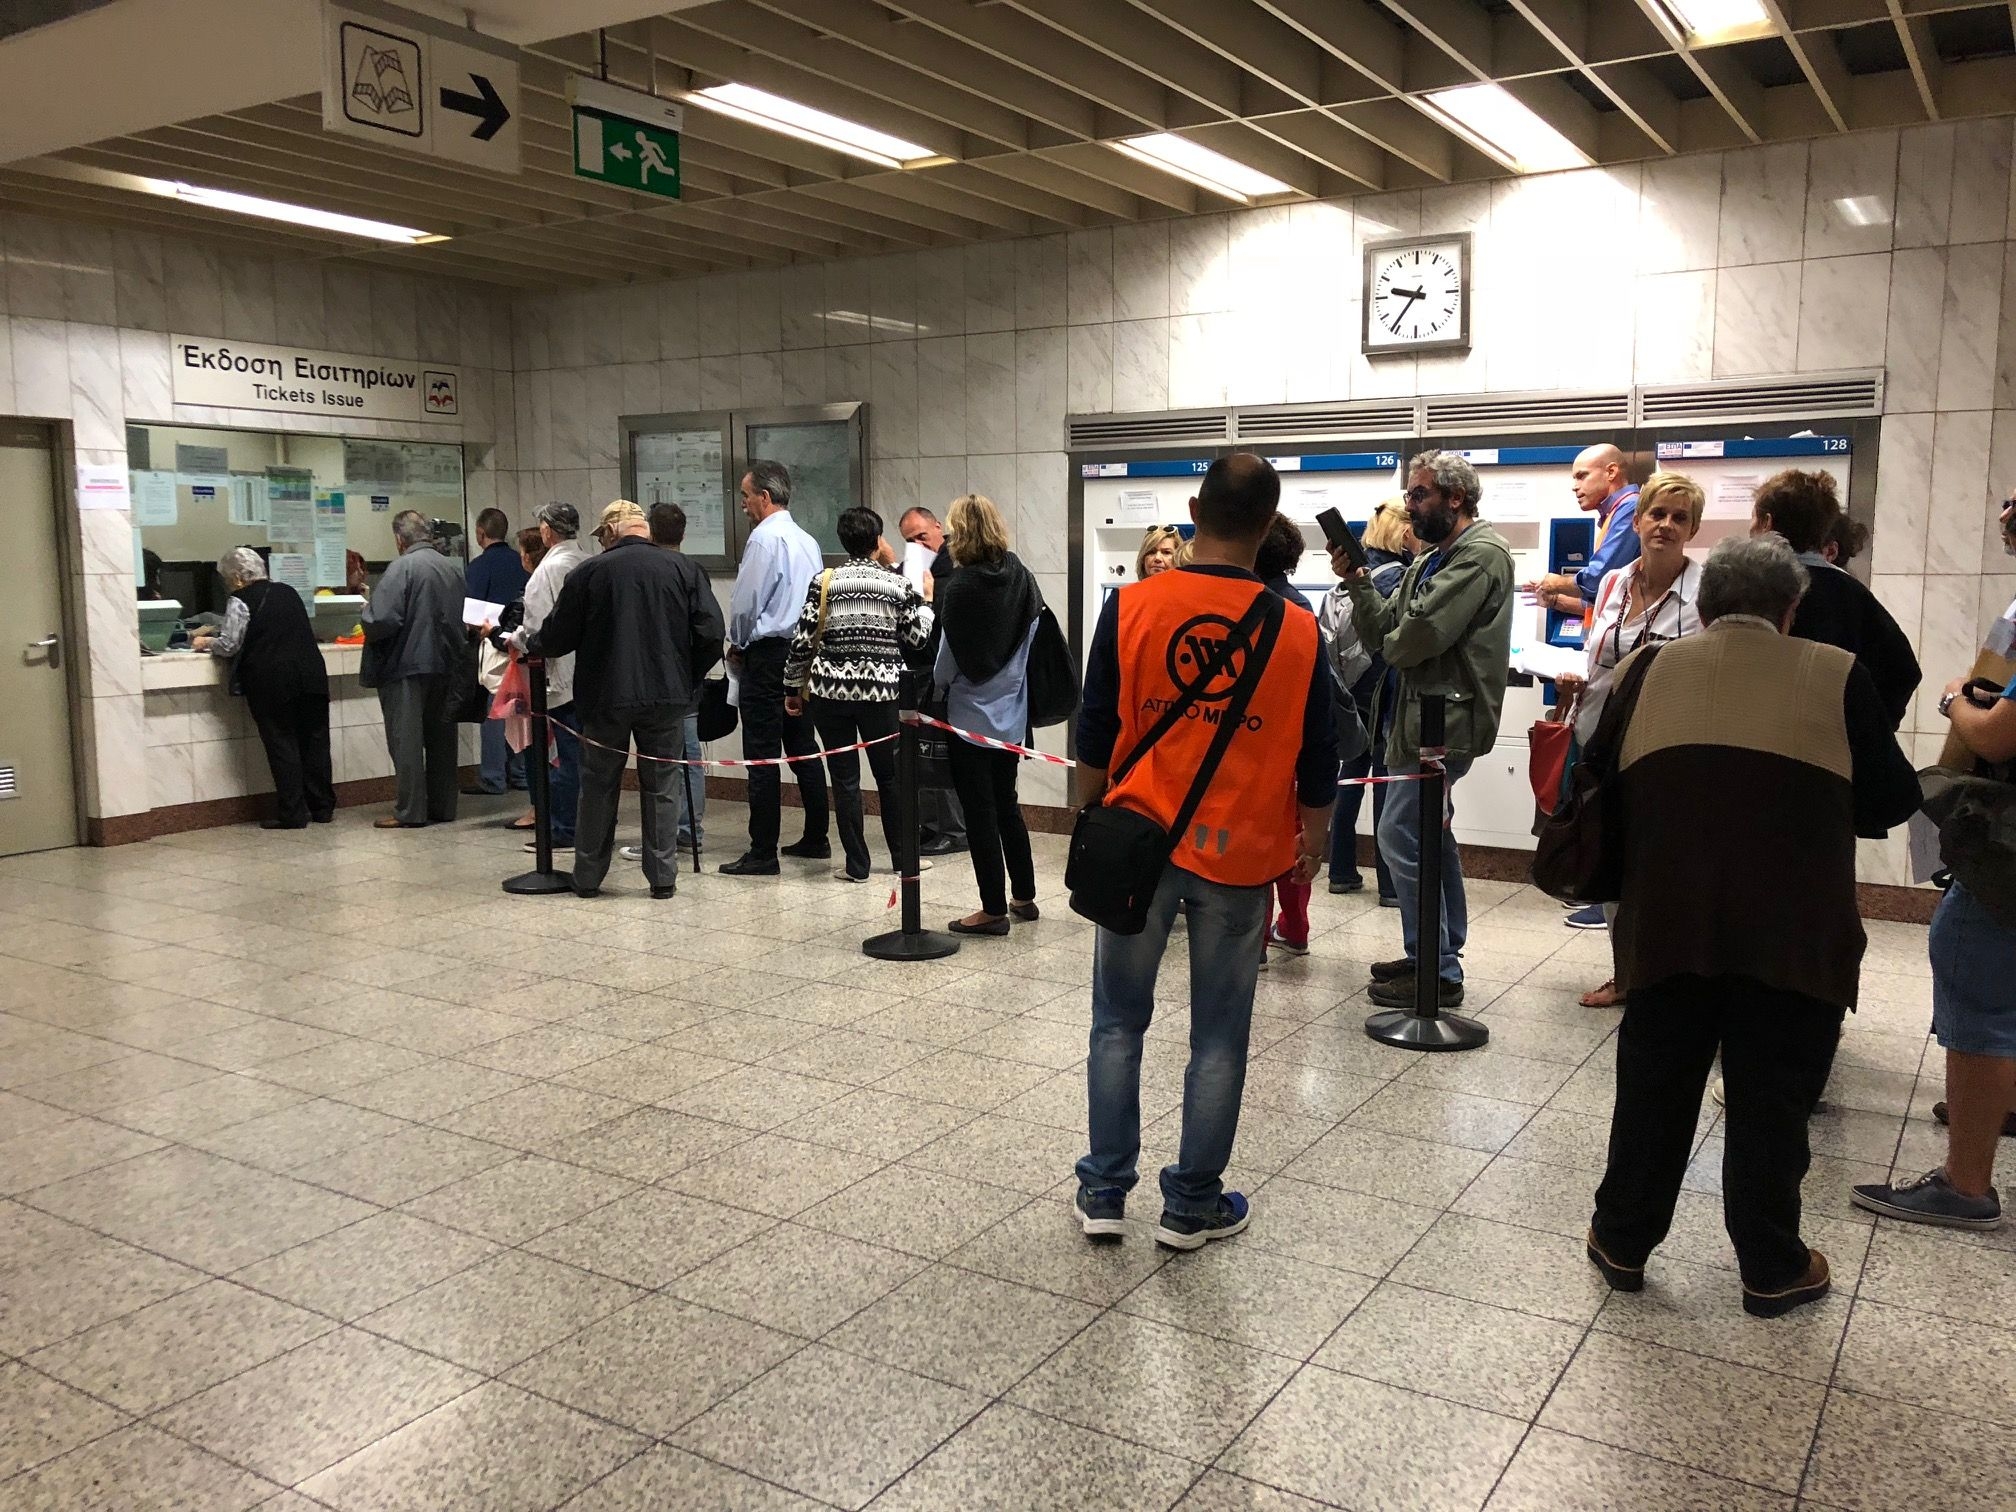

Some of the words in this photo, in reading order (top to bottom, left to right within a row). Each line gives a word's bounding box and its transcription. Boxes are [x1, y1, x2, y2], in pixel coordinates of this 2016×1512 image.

[178, 344, 283, 381] Έκδοση
[294, 356, 416, 390] Εισιτηρίων
[252, 383, 316, 404] Tickets
[322, 389, 364, 408] Issue
[1823, 438, 1848, 451] 128
[1192, 462, 1208, 472] 125
[1375, 455, 1395, 466] 126
